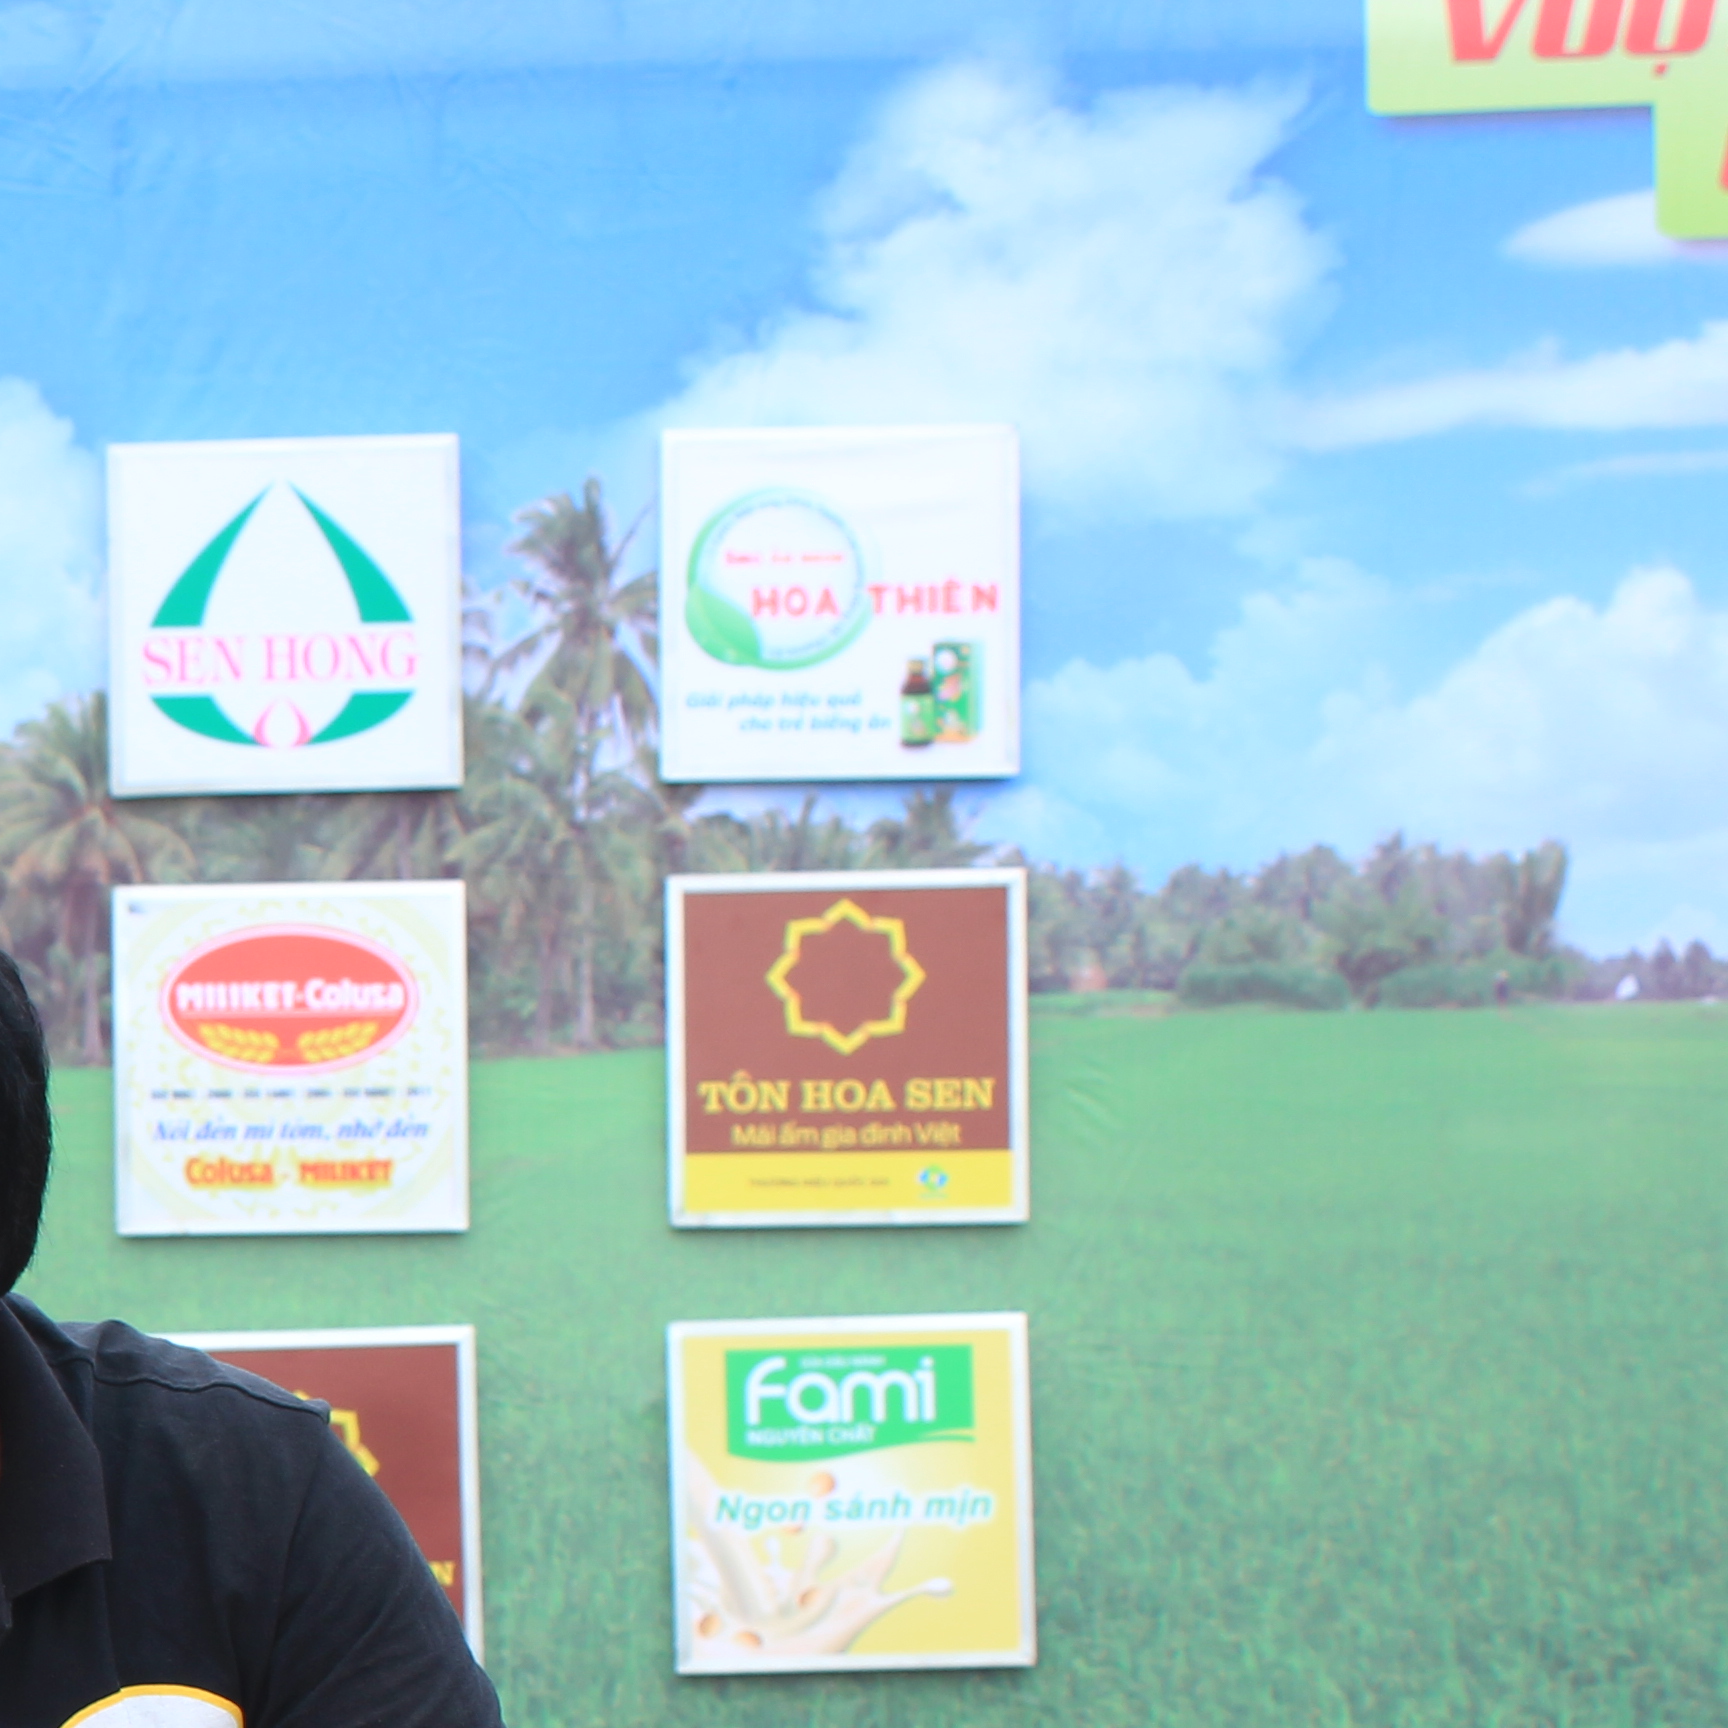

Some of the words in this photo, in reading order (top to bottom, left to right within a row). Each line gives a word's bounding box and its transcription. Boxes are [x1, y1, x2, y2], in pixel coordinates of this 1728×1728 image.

[752, 584, 842, 618] HOA
[867, 575, 999, 616] THIÊN
[142, 632, 248, 686] SEN
[261, 630, 421, 683] HONG
[698, 1069, 791, 1115] TÔN
[801, 1078, 896, 1114] HOA
[904, 1076, 996, 1112] SEN
[185, 1154, 274, 1185] Colusa
[716, 1494, 812, 1529] Ngon
[824, 1490, 912, 1522] sánh
[924, 1489, 994, 1526] mịn
